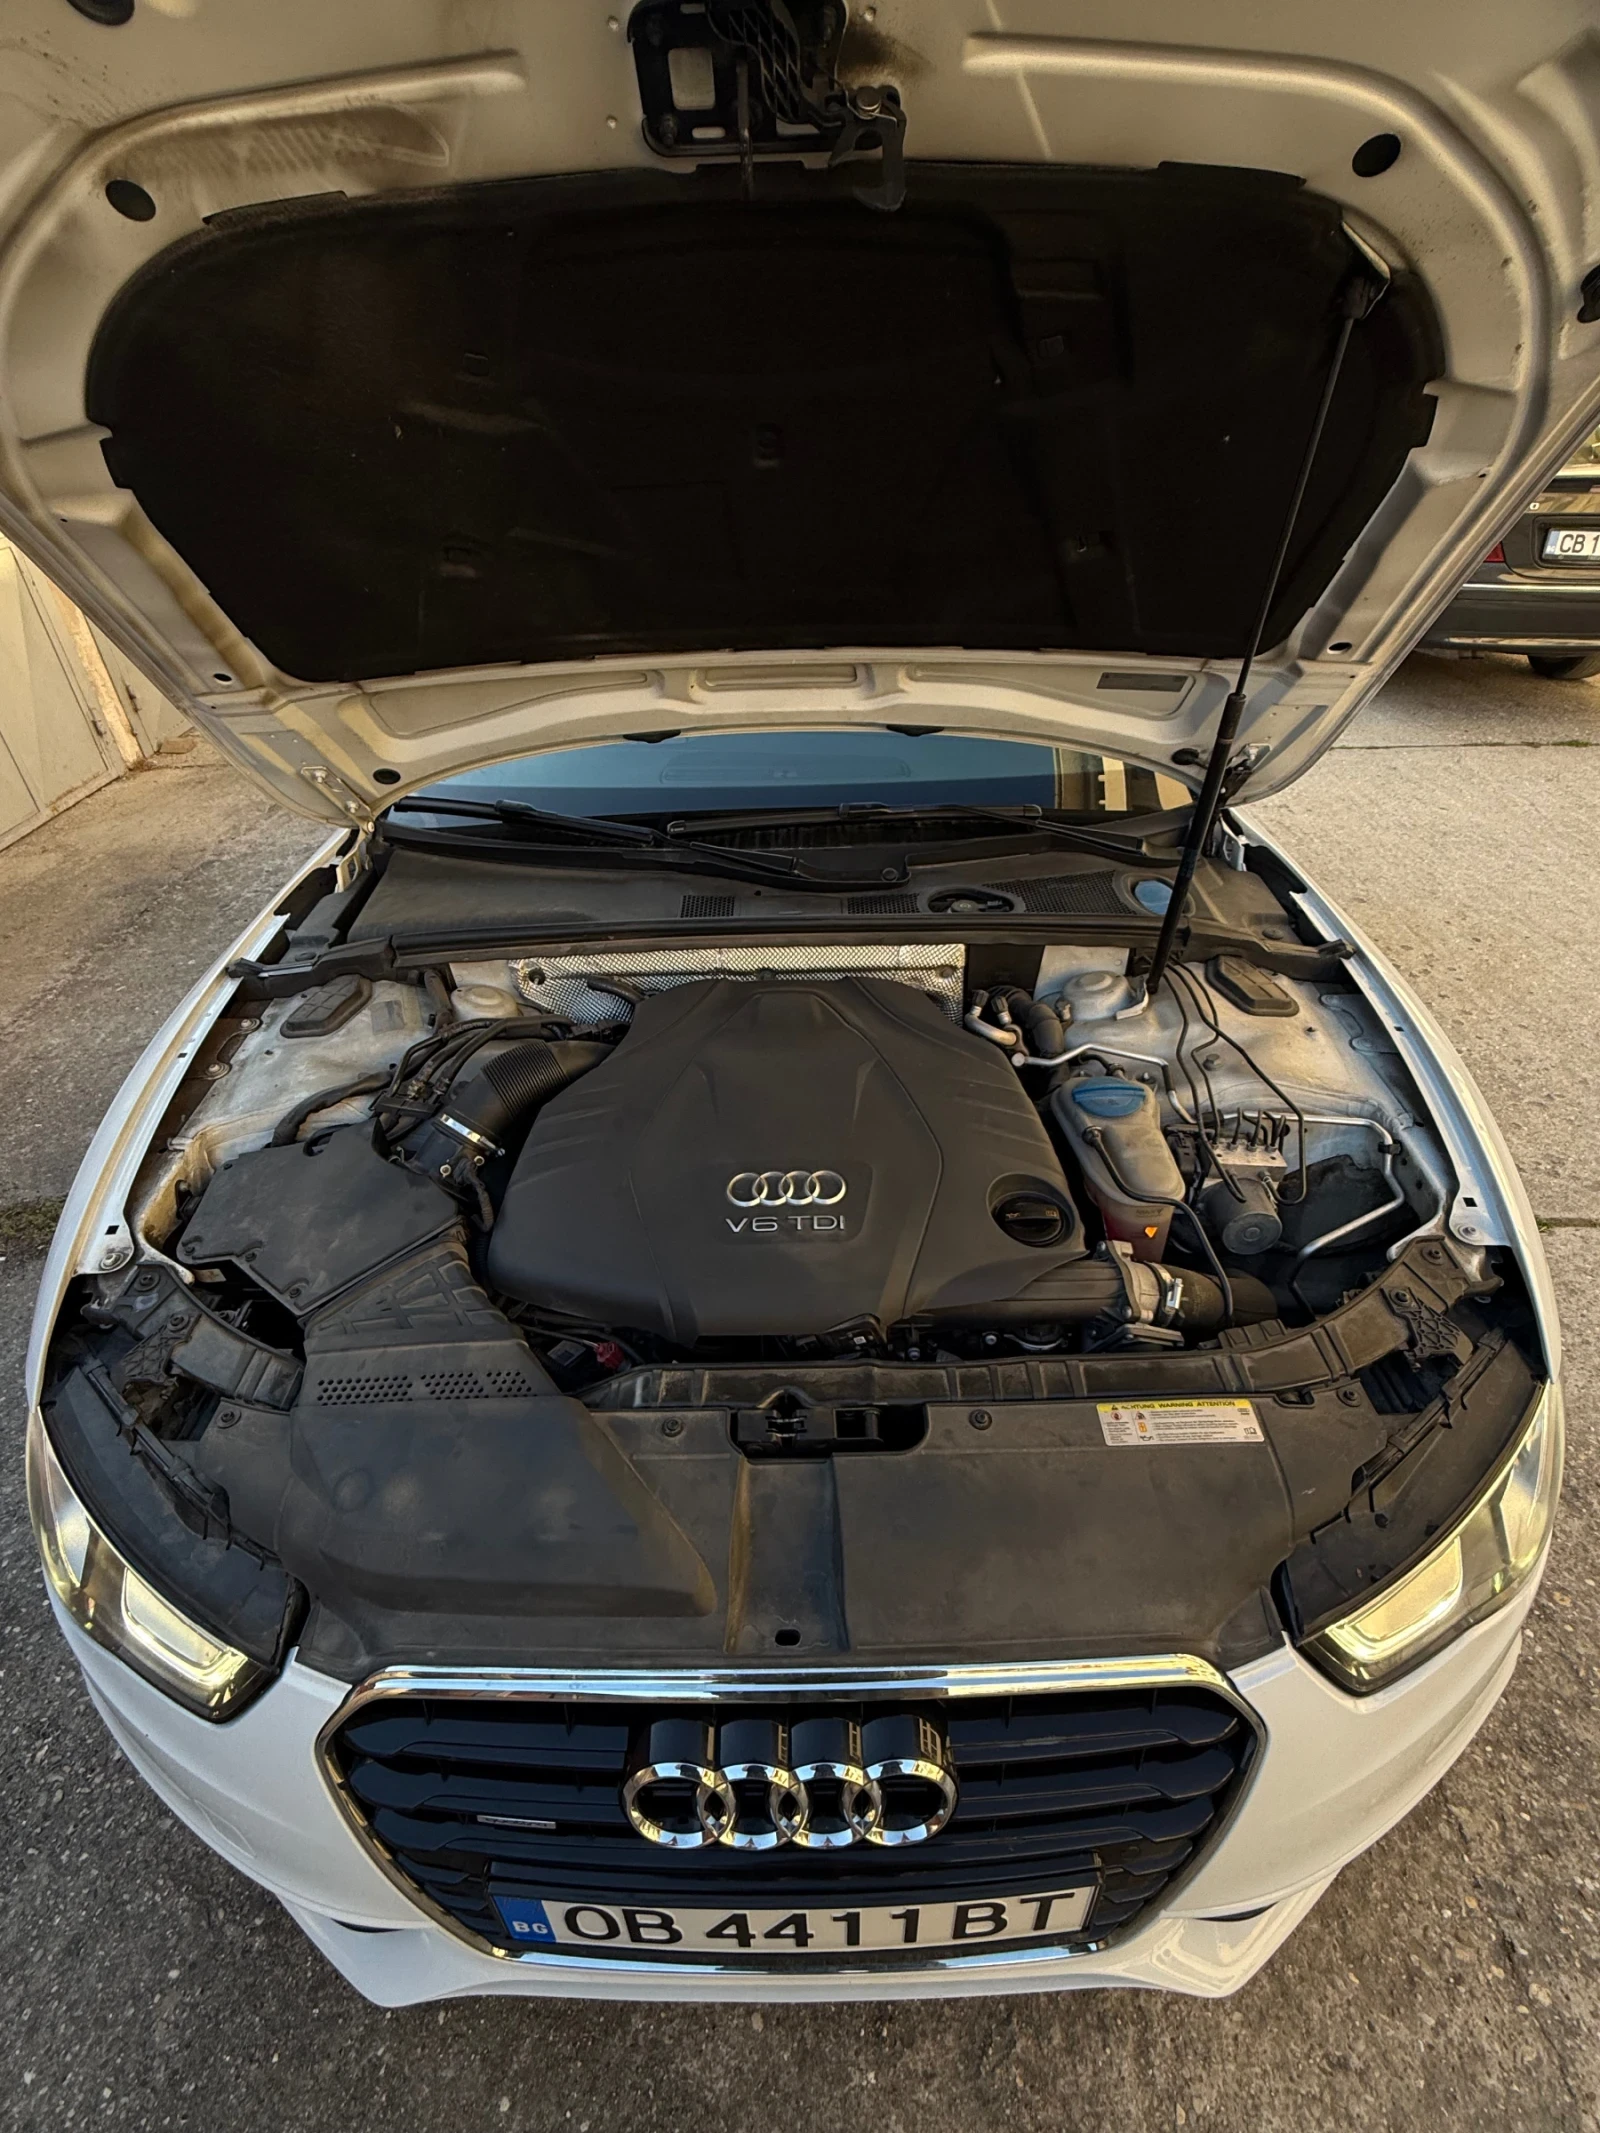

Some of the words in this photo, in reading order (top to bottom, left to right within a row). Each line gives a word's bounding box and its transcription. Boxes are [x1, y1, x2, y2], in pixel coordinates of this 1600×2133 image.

[1560, 534, 1586, 553] CB
[725, 1216, 778, 1232] V6
[787, 1214, 845, 1230] TDI
[512, 1920, 548, 1934] BG
[564, 1905, 683, 1944] OB
[705, 1908, 920, 1948] 4411
[952, 1892, 1075, 1939] BT
